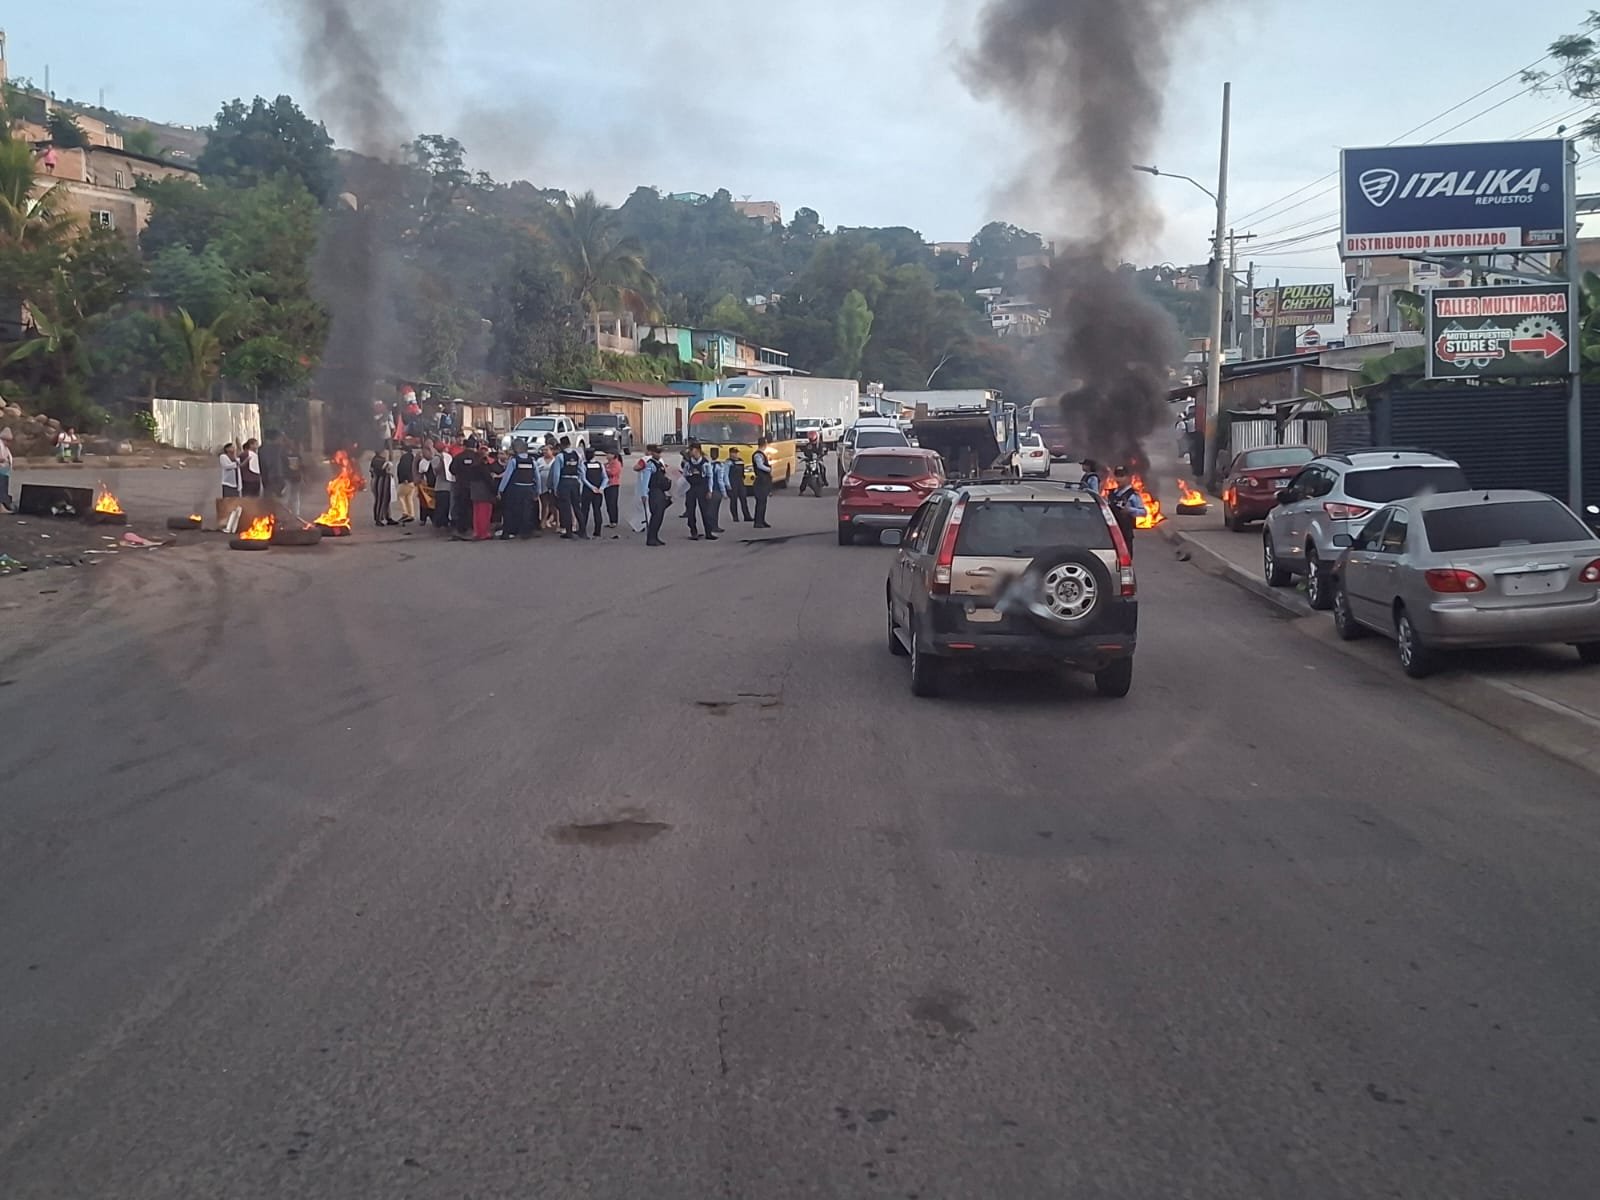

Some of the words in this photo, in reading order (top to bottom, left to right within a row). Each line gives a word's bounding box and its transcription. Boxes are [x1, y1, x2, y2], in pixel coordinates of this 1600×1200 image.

[1399, 167, 1541, 199] ITALIKA
[1475, 194, 1534, 205] REPUESTOS
[1347, 235, 1431, 251] DISTRIBUIDOR
[1434, 232, 1506, 248] AUTORIZADO
[1282, 285, 1333, 299] POLLOS
[1281, 297, 1333, 310] CHEPYTA
[1436, 298, 1479, 316] TALLER
[1481, 294, 1566, 315] MULTIMARCA
